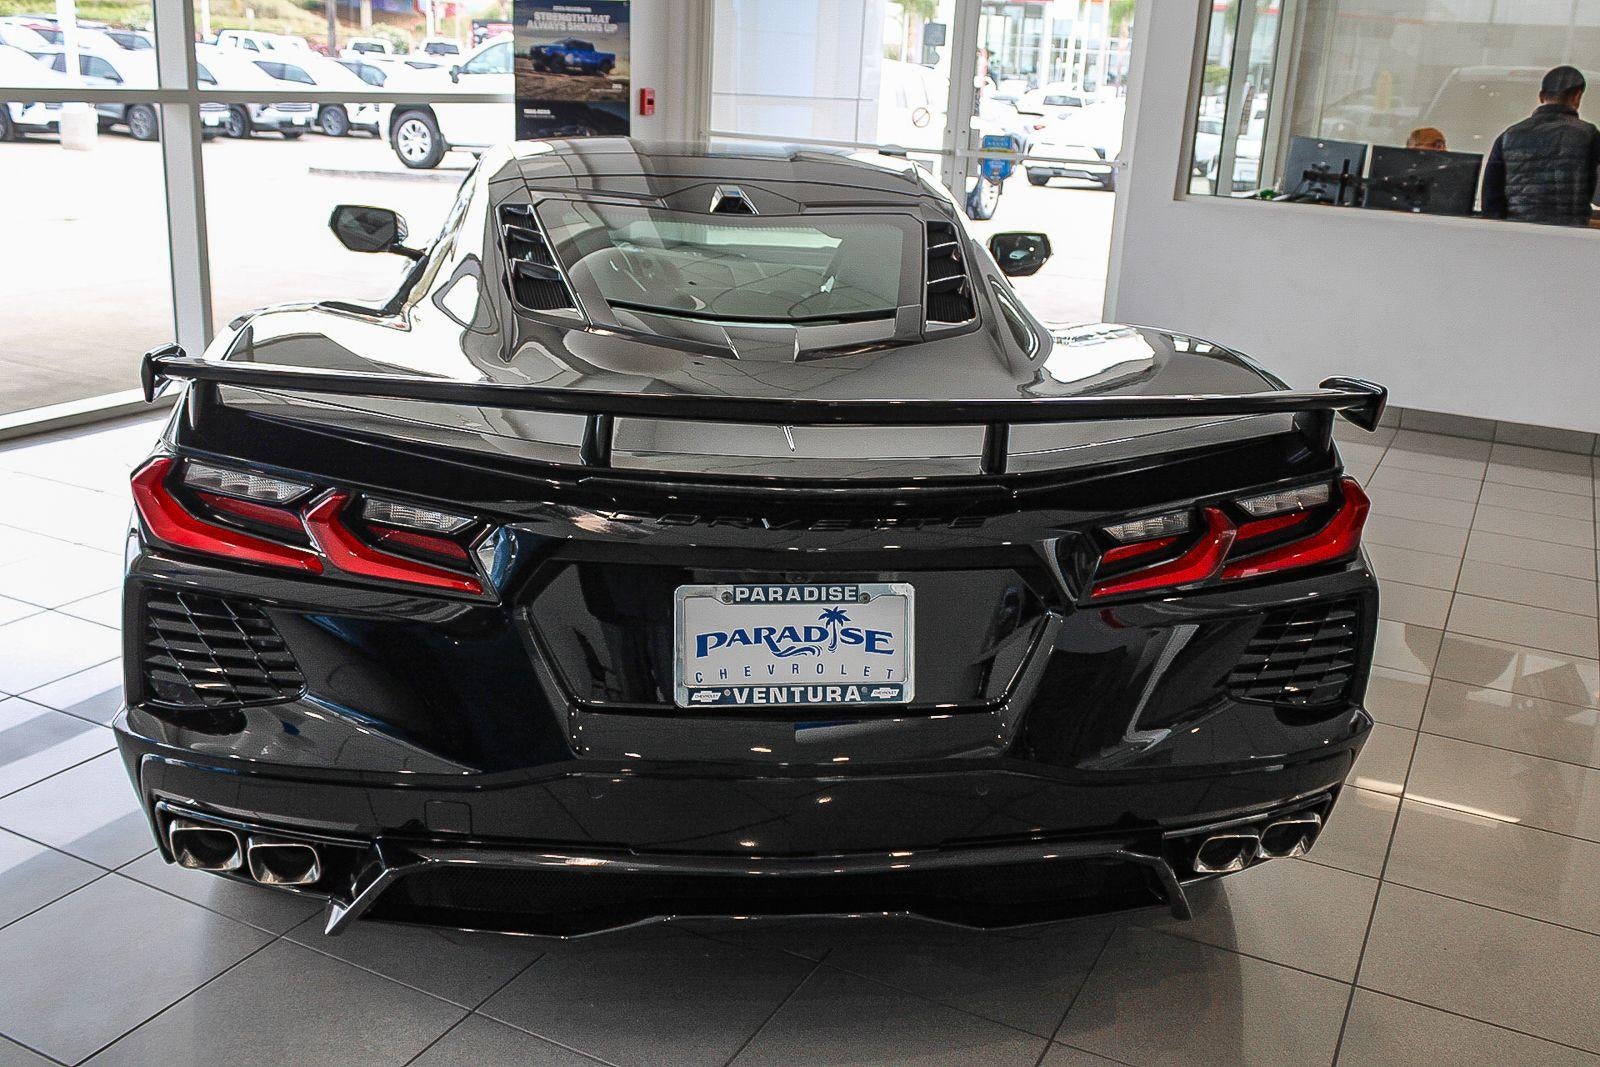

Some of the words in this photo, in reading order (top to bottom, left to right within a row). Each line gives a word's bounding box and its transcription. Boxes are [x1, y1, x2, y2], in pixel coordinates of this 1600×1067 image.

[735, 585, 857, 602] PARADISE
[696, 607, 895, 658] PARADISE
[695, 663, 894, 684] CHEVROLET
[733, 686, 861, 704] VENTURA
